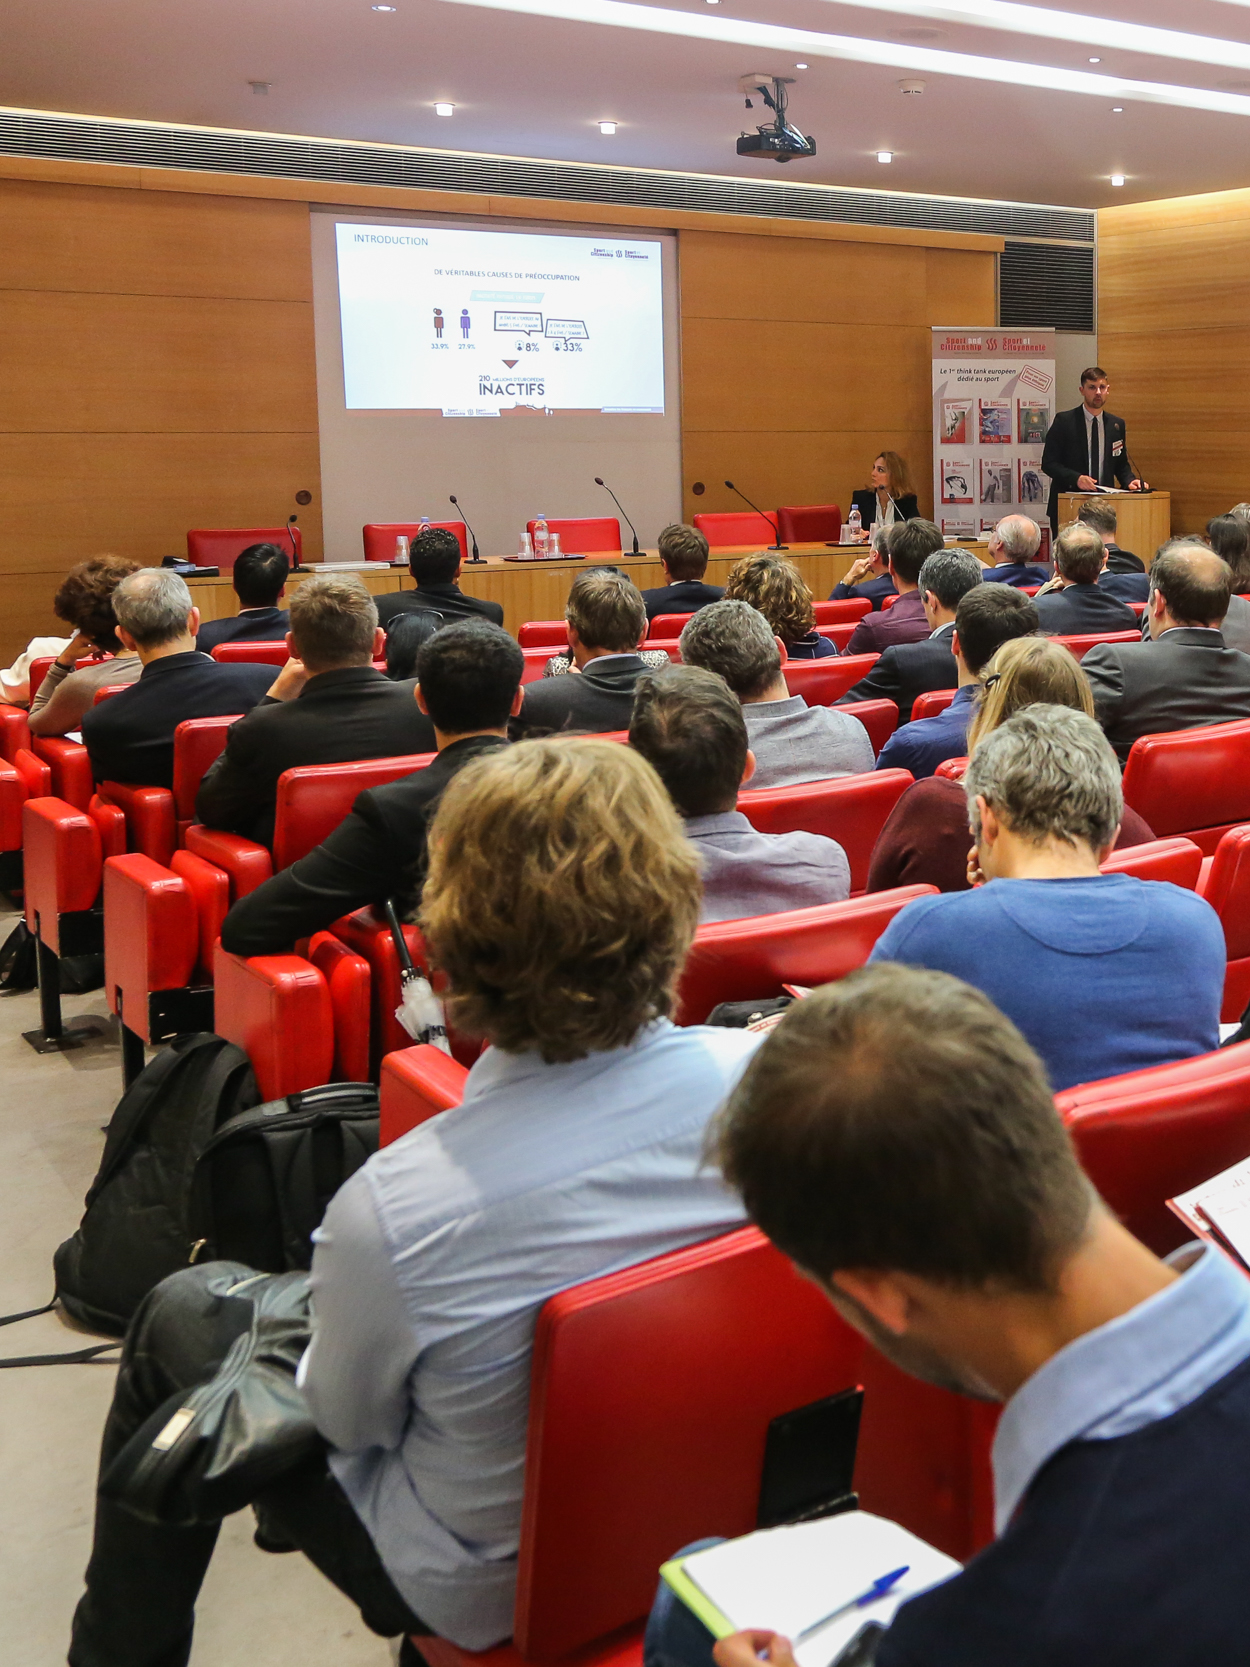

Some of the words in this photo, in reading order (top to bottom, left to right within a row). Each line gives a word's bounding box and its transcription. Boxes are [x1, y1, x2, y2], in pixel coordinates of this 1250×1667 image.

[354, 234, 428, 246] INTRODUCTION
[445, 269, 486, 277] VÉRITABLES
[487, 271, 513, 279] CAUSES
[525, 272, 580, 281] PRÉOCCUPATION
[525, 342, 540, 352] 8%
[563, 342, 583, 352] 33%
[940, 343, 982, 351] Citizenship
[988, 368, 1017, 376] européen
[479, 383, 545, 395] INACTIFS
